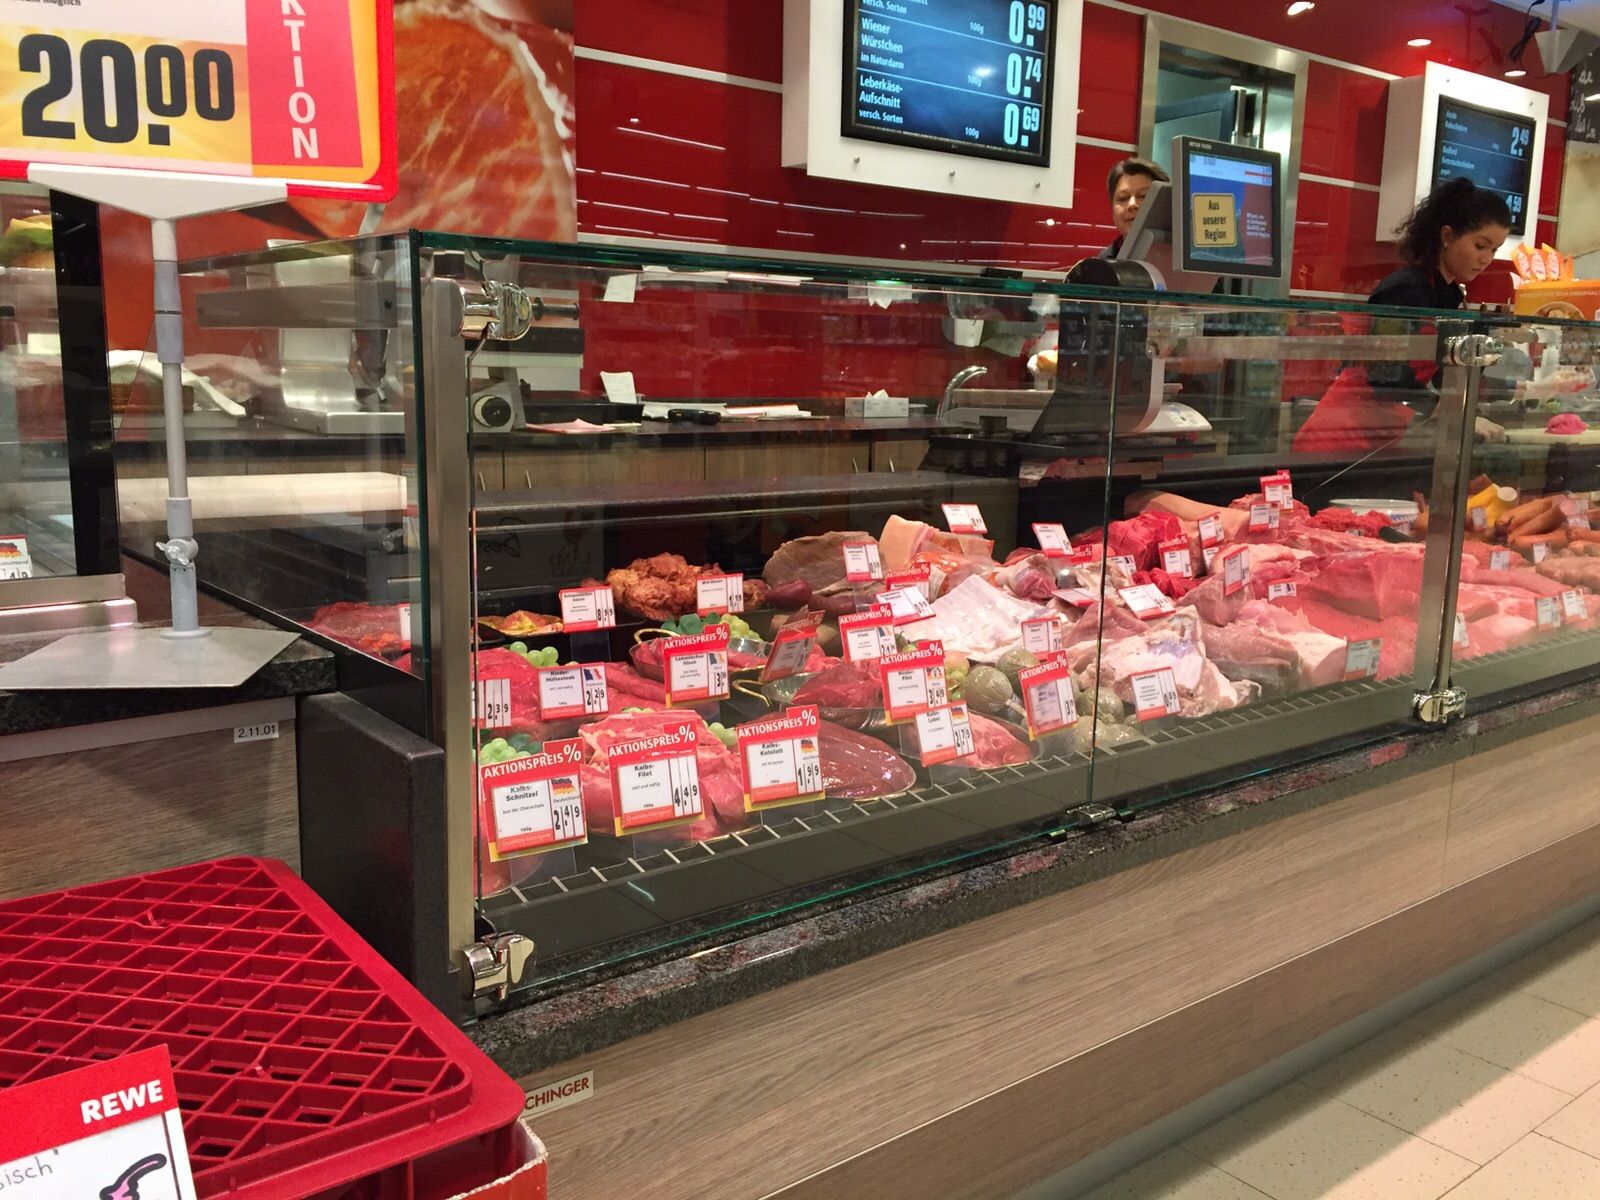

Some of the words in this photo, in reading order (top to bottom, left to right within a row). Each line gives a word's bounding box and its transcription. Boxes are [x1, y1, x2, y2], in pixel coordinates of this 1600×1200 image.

[861, 17, 891, 34] Wiener
[1008, 0, 1046, 47] 0.99
[861, 33, 903, 53] Würstchen
[1006, 53, 1042, 98] 0.74
[860, 75, 903, 92] Leberkäse-
[859, 90, 901, 108] Aufschnitt
[859, 110, 882, 121] versch.
[882, 111, 904, 124] Sorten
[1004, 103, 1040, 147] 0.69
[965, 127, 980, 139] 100g
[1208, 200, 1220, 211] Aus
[1202, 216, 1227, 226] unserer
[1204, 229, 1227, 241] Region
[238, 724, 275, 739] 2.11.01
[633, 763, 655, 771] Kalbs-
[637, 770, 653, 778] Filet
[505, 790, 539, 802] Schnitzel
[510, 785, 533, 793] Kalbs-
[525, 1077, 590, 1110] CHINGER
[80, 1079, 164, 1125] REWE
